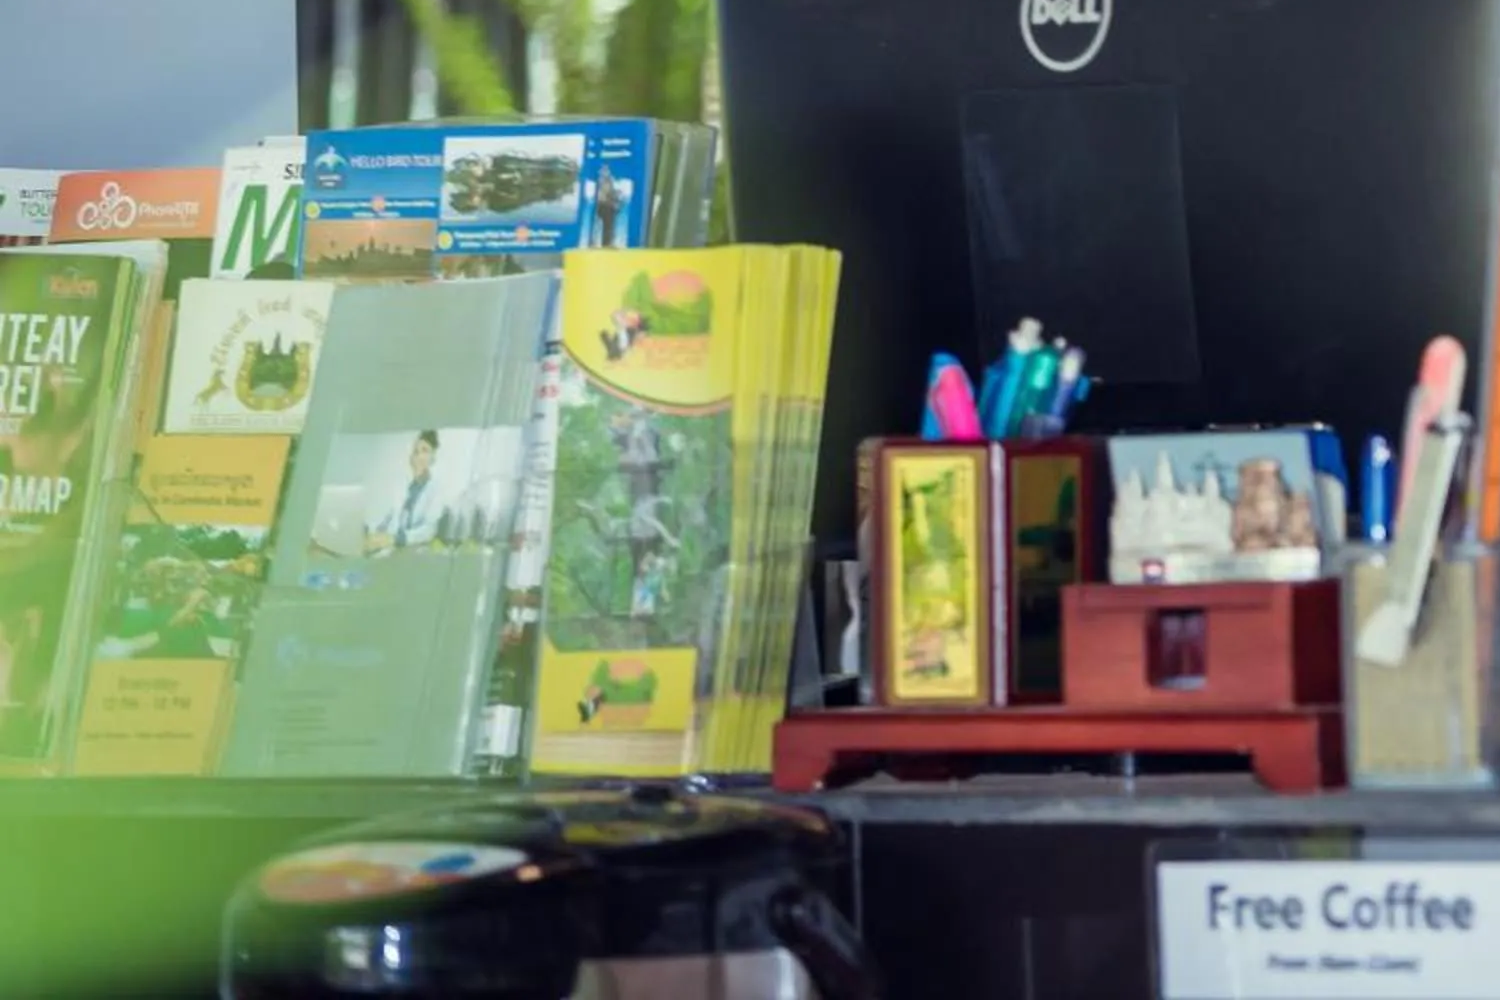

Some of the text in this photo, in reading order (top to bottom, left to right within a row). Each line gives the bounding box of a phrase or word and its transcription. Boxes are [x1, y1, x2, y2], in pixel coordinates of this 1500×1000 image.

[0, 314, 91, 364] TEAY
[1207, 881, 1475, 931] Free Coffee
